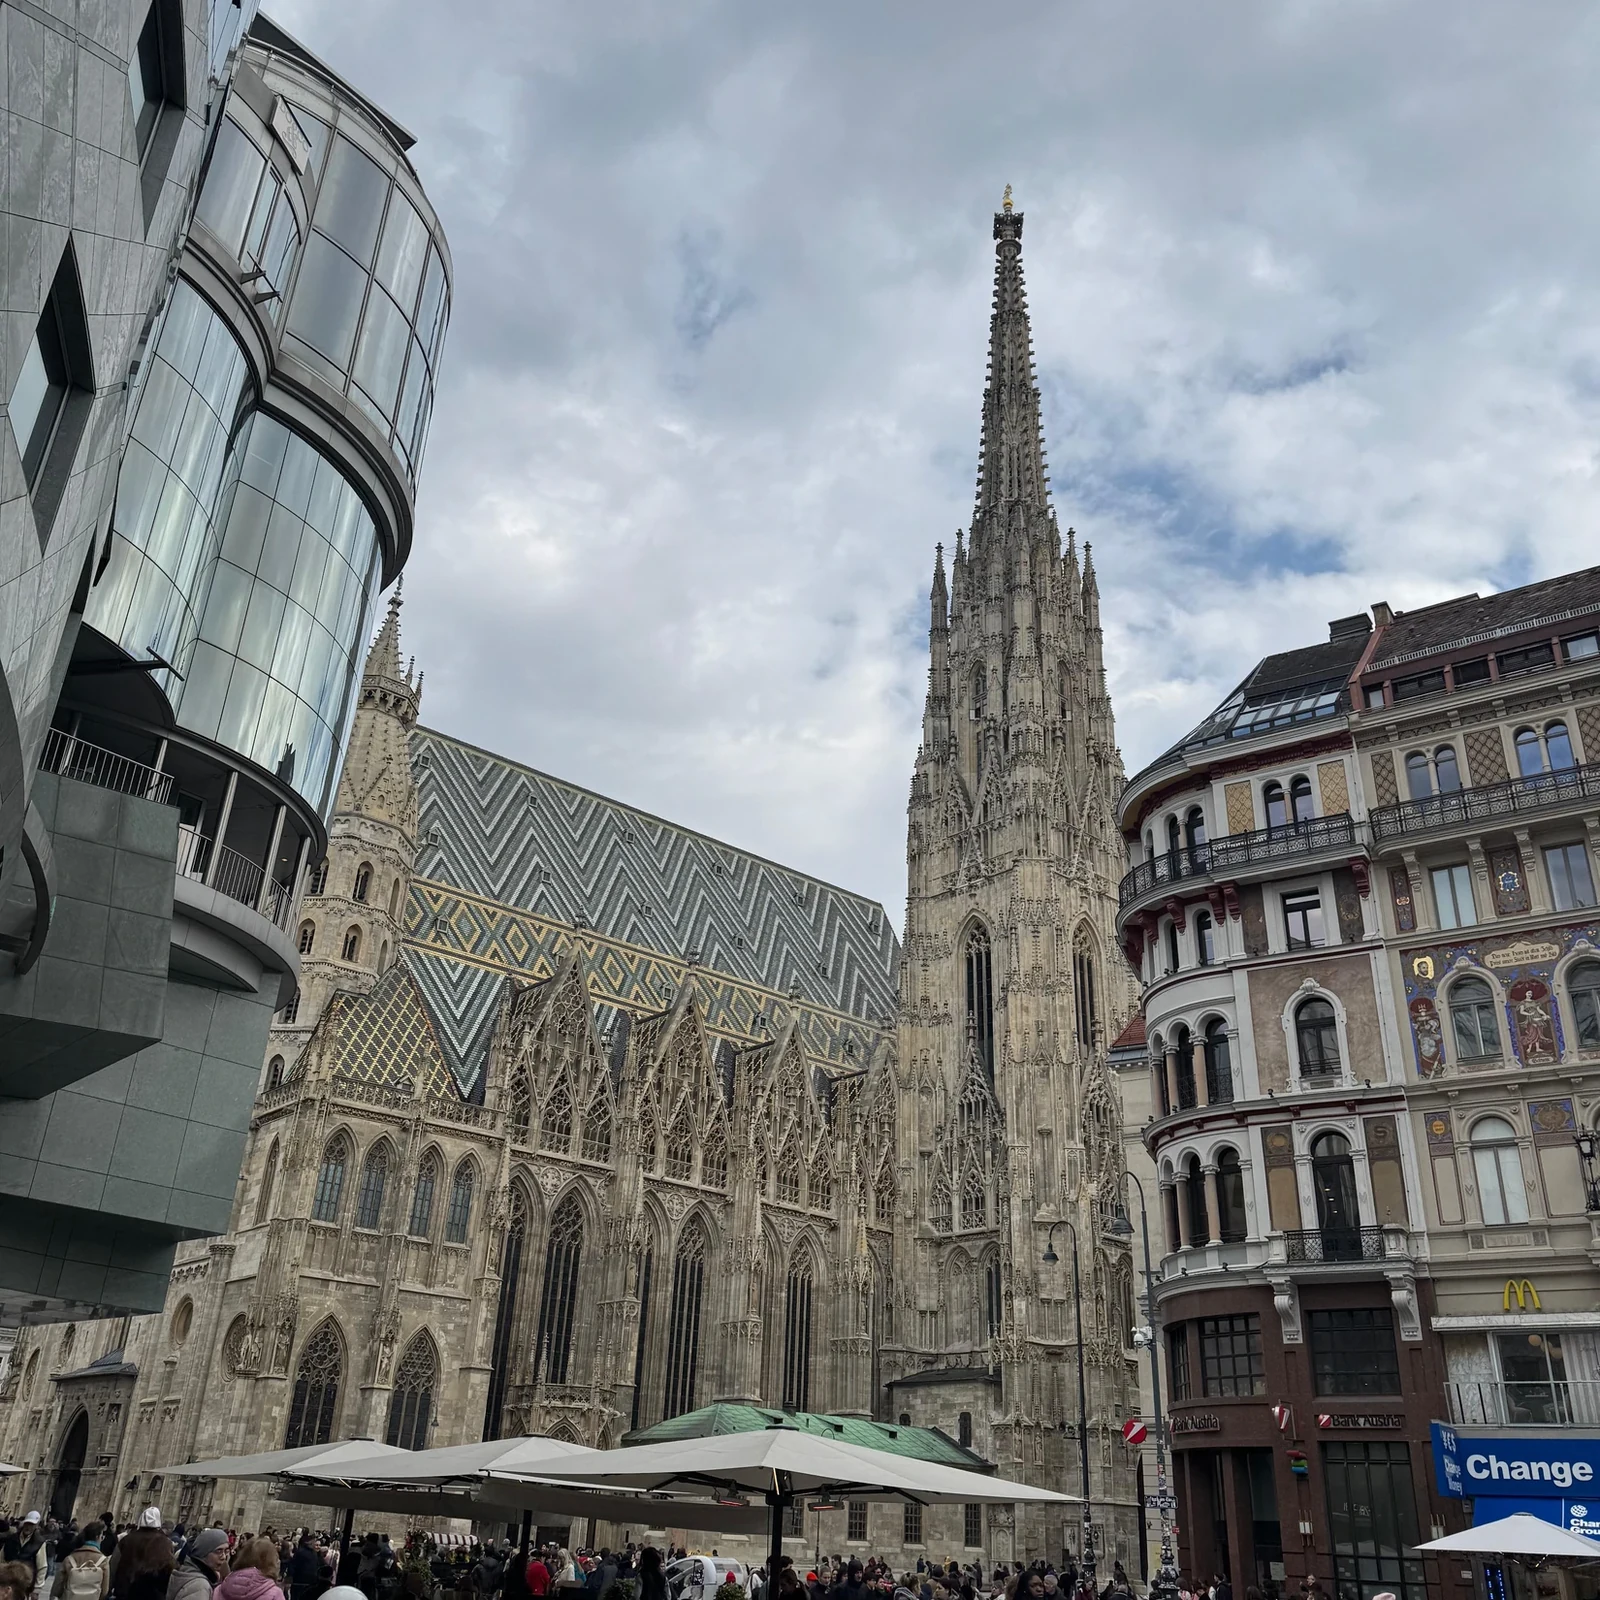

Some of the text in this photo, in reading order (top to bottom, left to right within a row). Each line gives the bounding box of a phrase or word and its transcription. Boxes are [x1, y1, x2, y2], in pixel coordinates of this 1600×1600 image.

[1332, 1413, 1401, 1427] Bank Austria
[1466, 1454, 1593, 1487] Change
